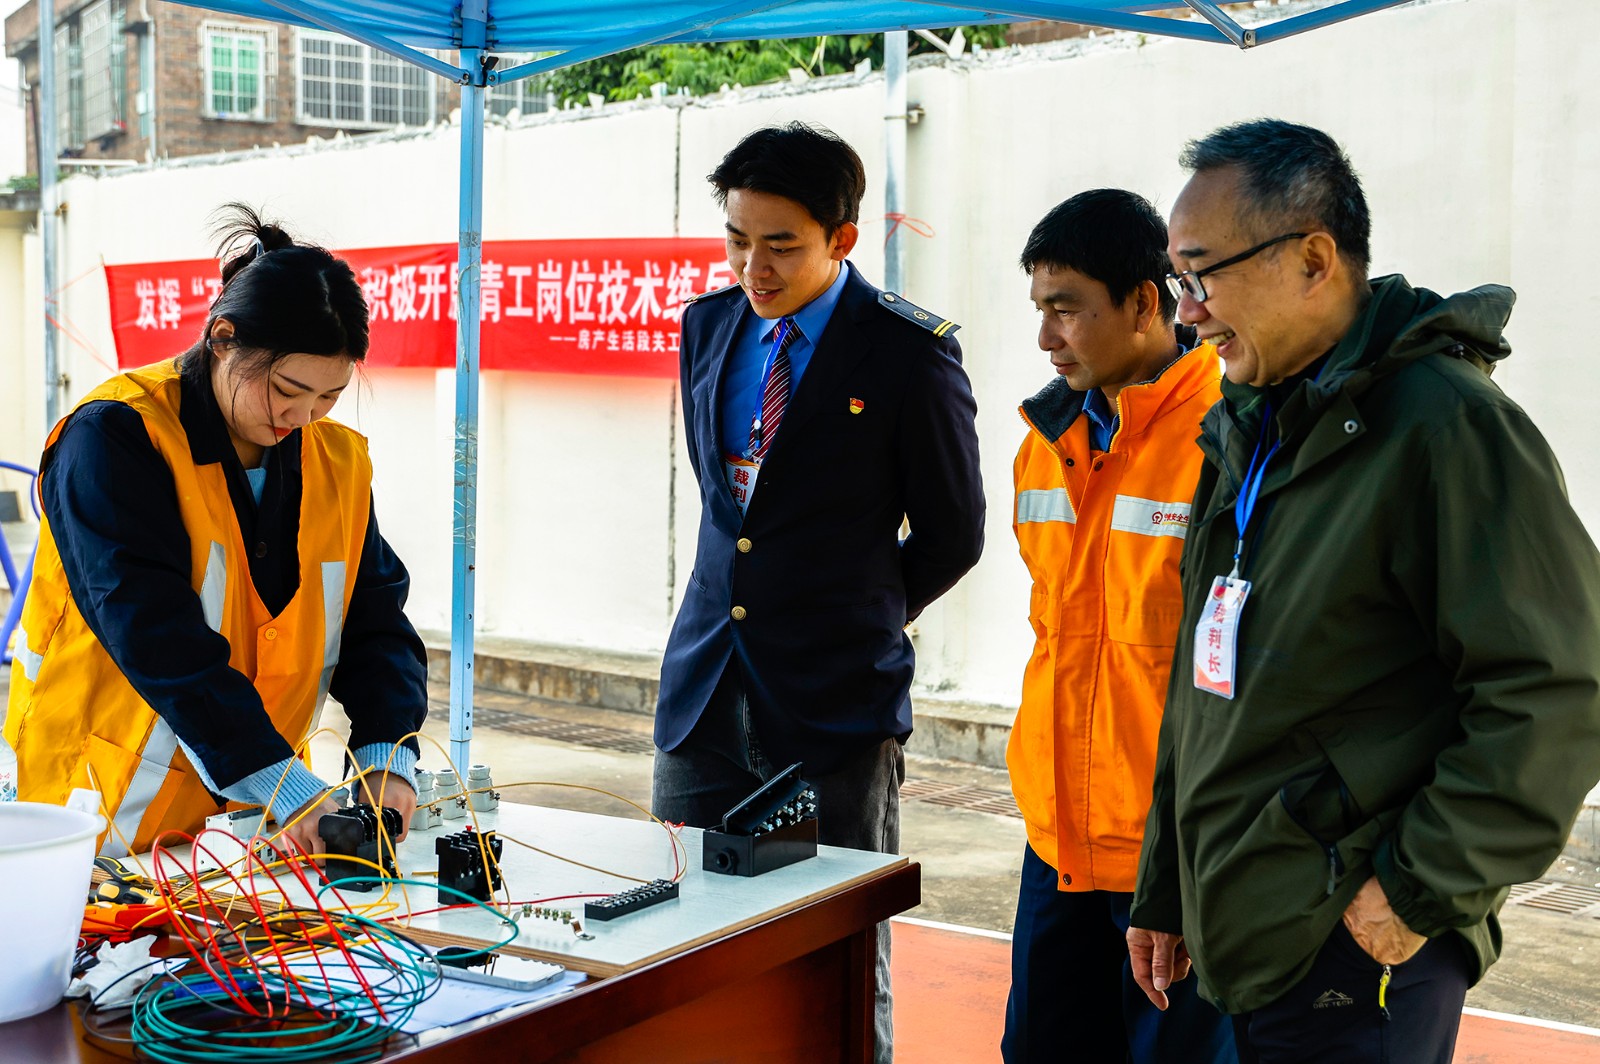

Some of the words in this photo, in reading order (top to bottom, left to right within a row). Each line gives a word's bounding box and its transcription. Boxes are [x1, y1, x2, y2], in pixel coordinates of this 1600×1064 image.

[361, 259, 733, 324] 积极开青工岗位技术练
[732, 467, 749, 512] 裁判
[1332, 999, 1353, 1007] TECH
